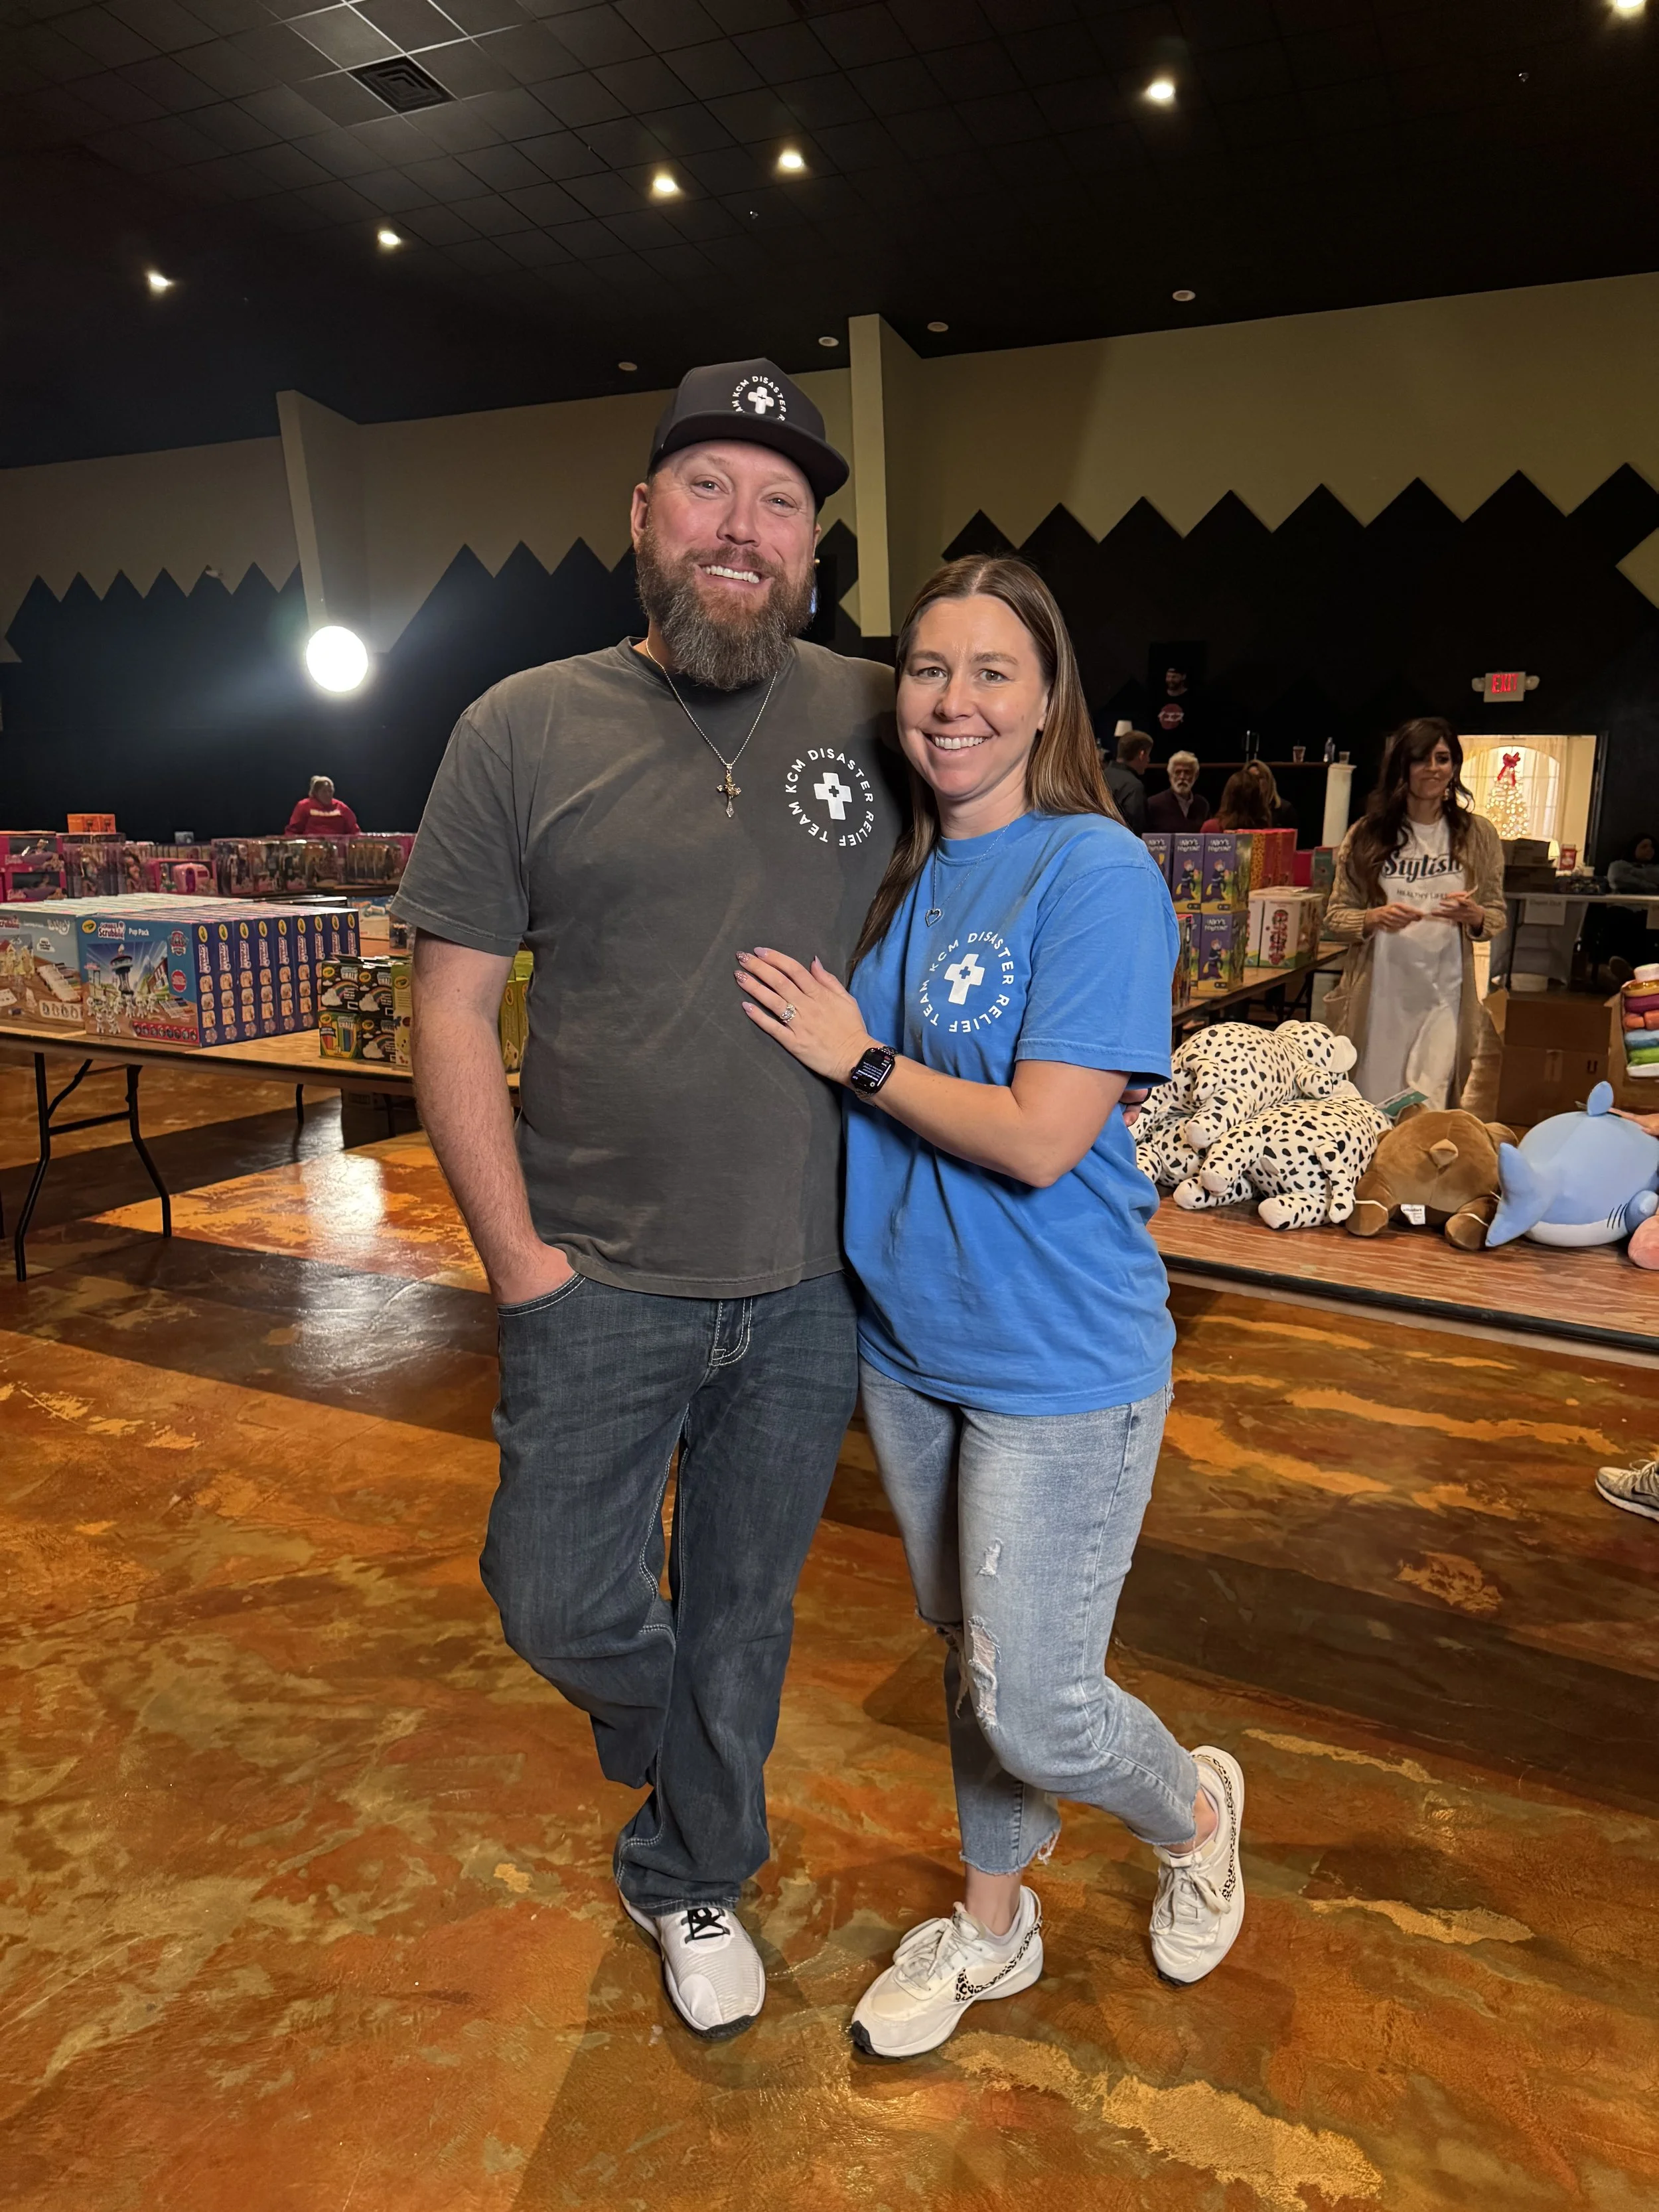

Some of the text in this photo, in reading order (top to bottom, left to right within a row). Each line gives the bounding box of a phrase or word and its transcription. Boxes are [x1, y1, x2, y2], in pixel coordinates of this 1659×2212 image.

[732, 379, 749, 398] KCM
[752, 376, 786, 413] DISASTER
[1491, 673, 1519, 694] EXIT
[785, 748, 874, 846] TEAM KCM DISASTER RELIEF
[1382, 850, 1461, 883] Stylish
[138, 928, 150, 936] Pack
[920, 931, 1014, 1033] TEAM KCM DISASTER RELIEF
